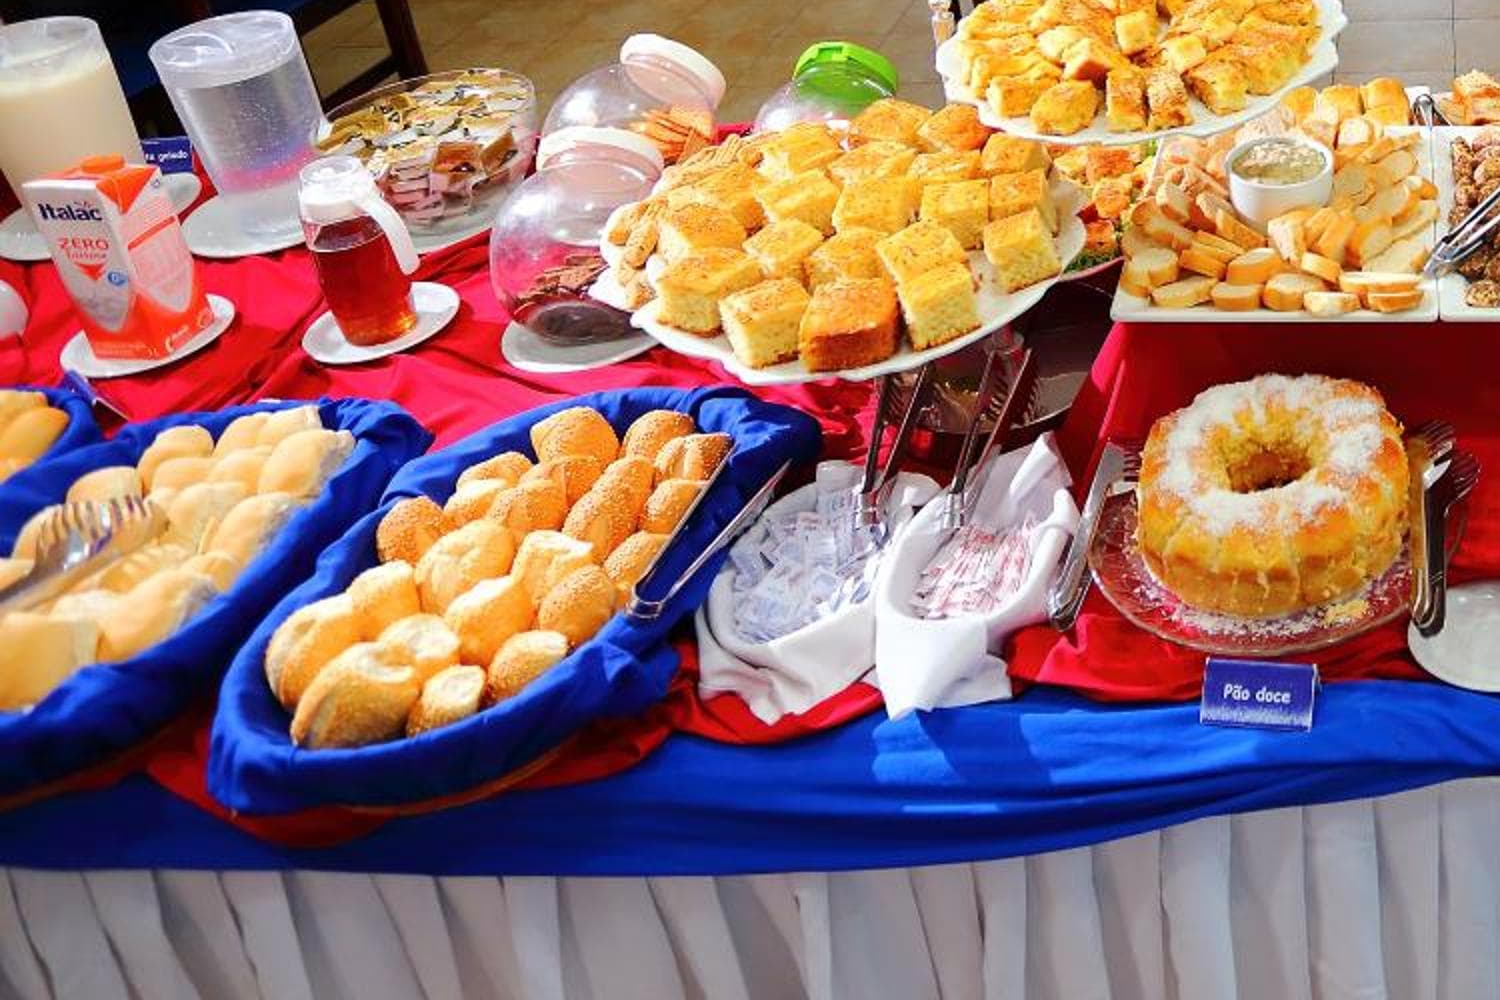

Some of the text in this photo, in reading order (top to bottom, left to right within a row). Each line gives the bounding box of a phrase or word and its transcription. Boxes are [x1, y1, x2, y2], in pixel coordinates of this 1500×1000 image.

[38, 203, 102, 221] Italac
[58, 237, 109, 250] ZERO
[1223, 683, 1291, 704] Pão doce
